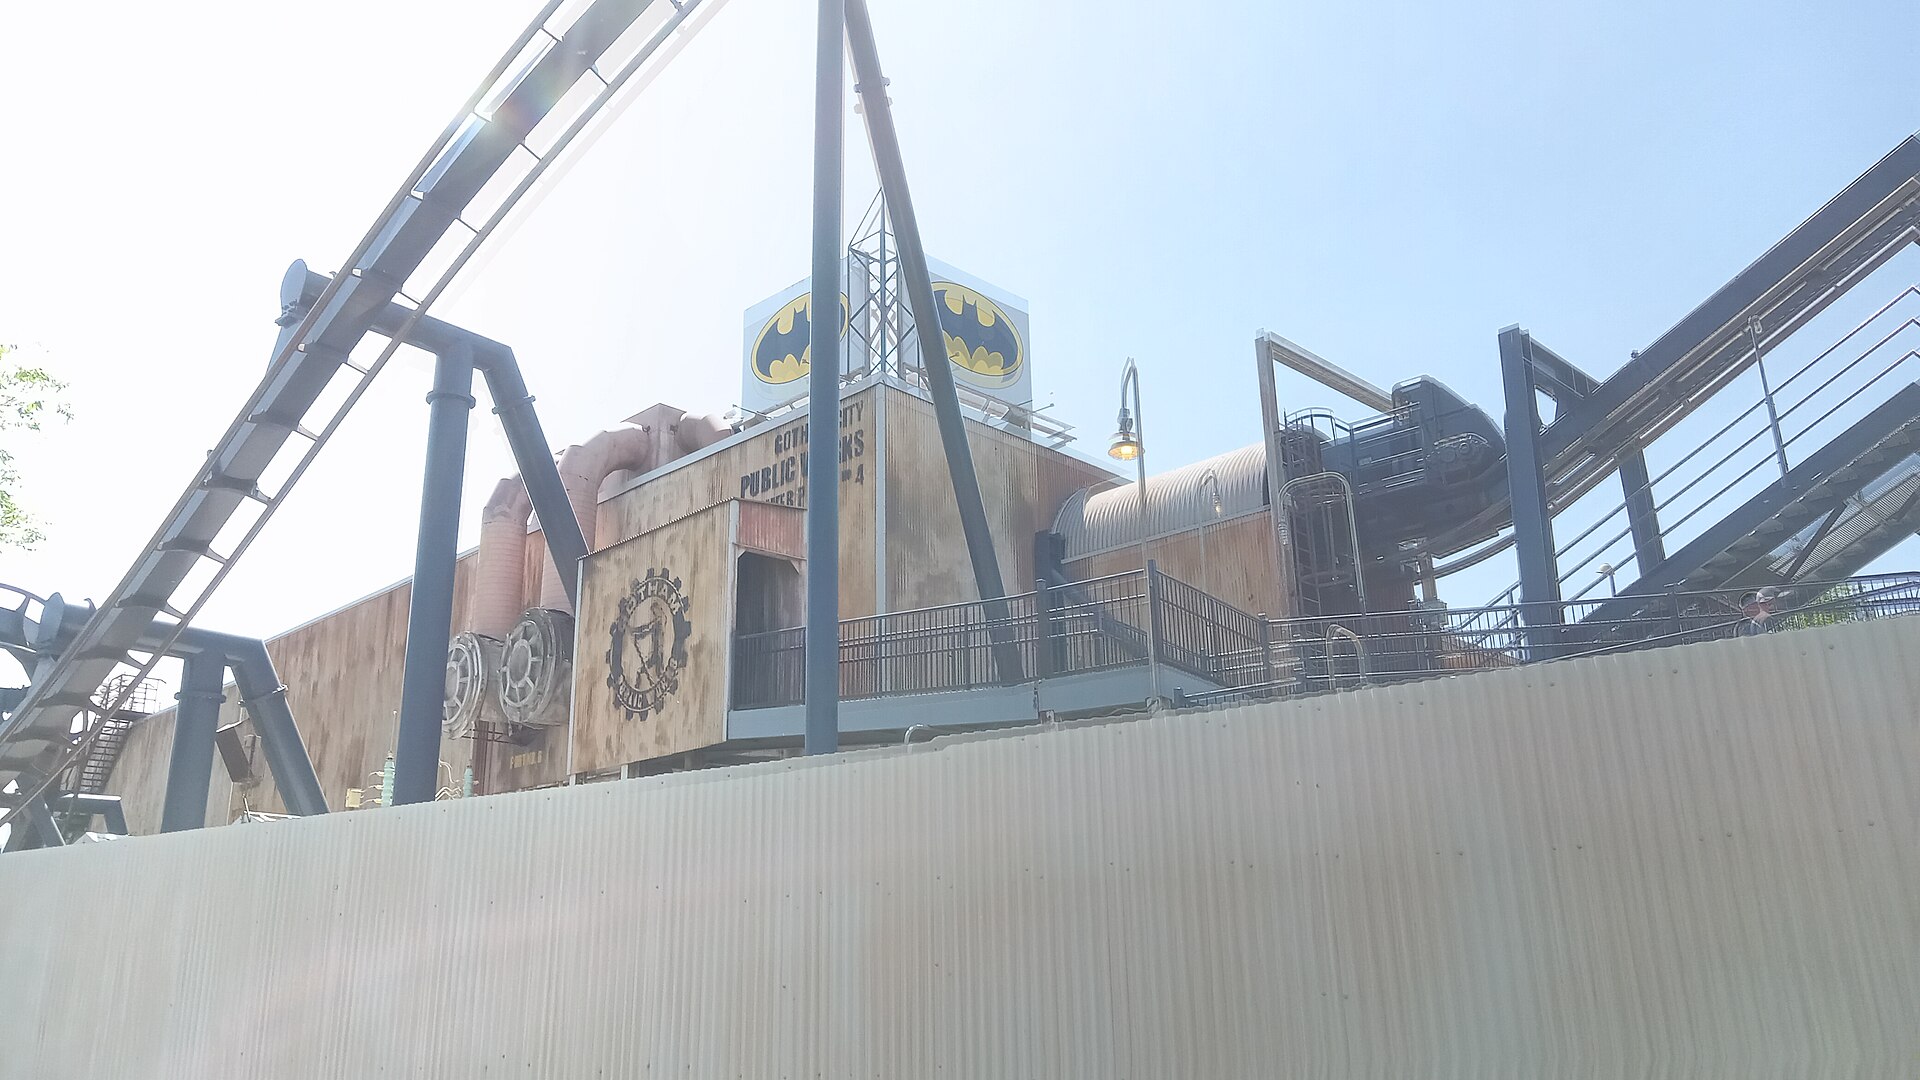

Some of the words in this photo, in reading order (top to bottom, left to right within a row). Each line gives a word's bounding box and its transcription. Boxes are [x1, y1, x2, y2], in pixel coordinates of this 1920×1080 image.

[774, 423, 809, 457] GOTH
[839, 401, 864, 428] ITY
[740, 455, 796, 499] PUBLIC
[800, 429, 865, 478] WKS
